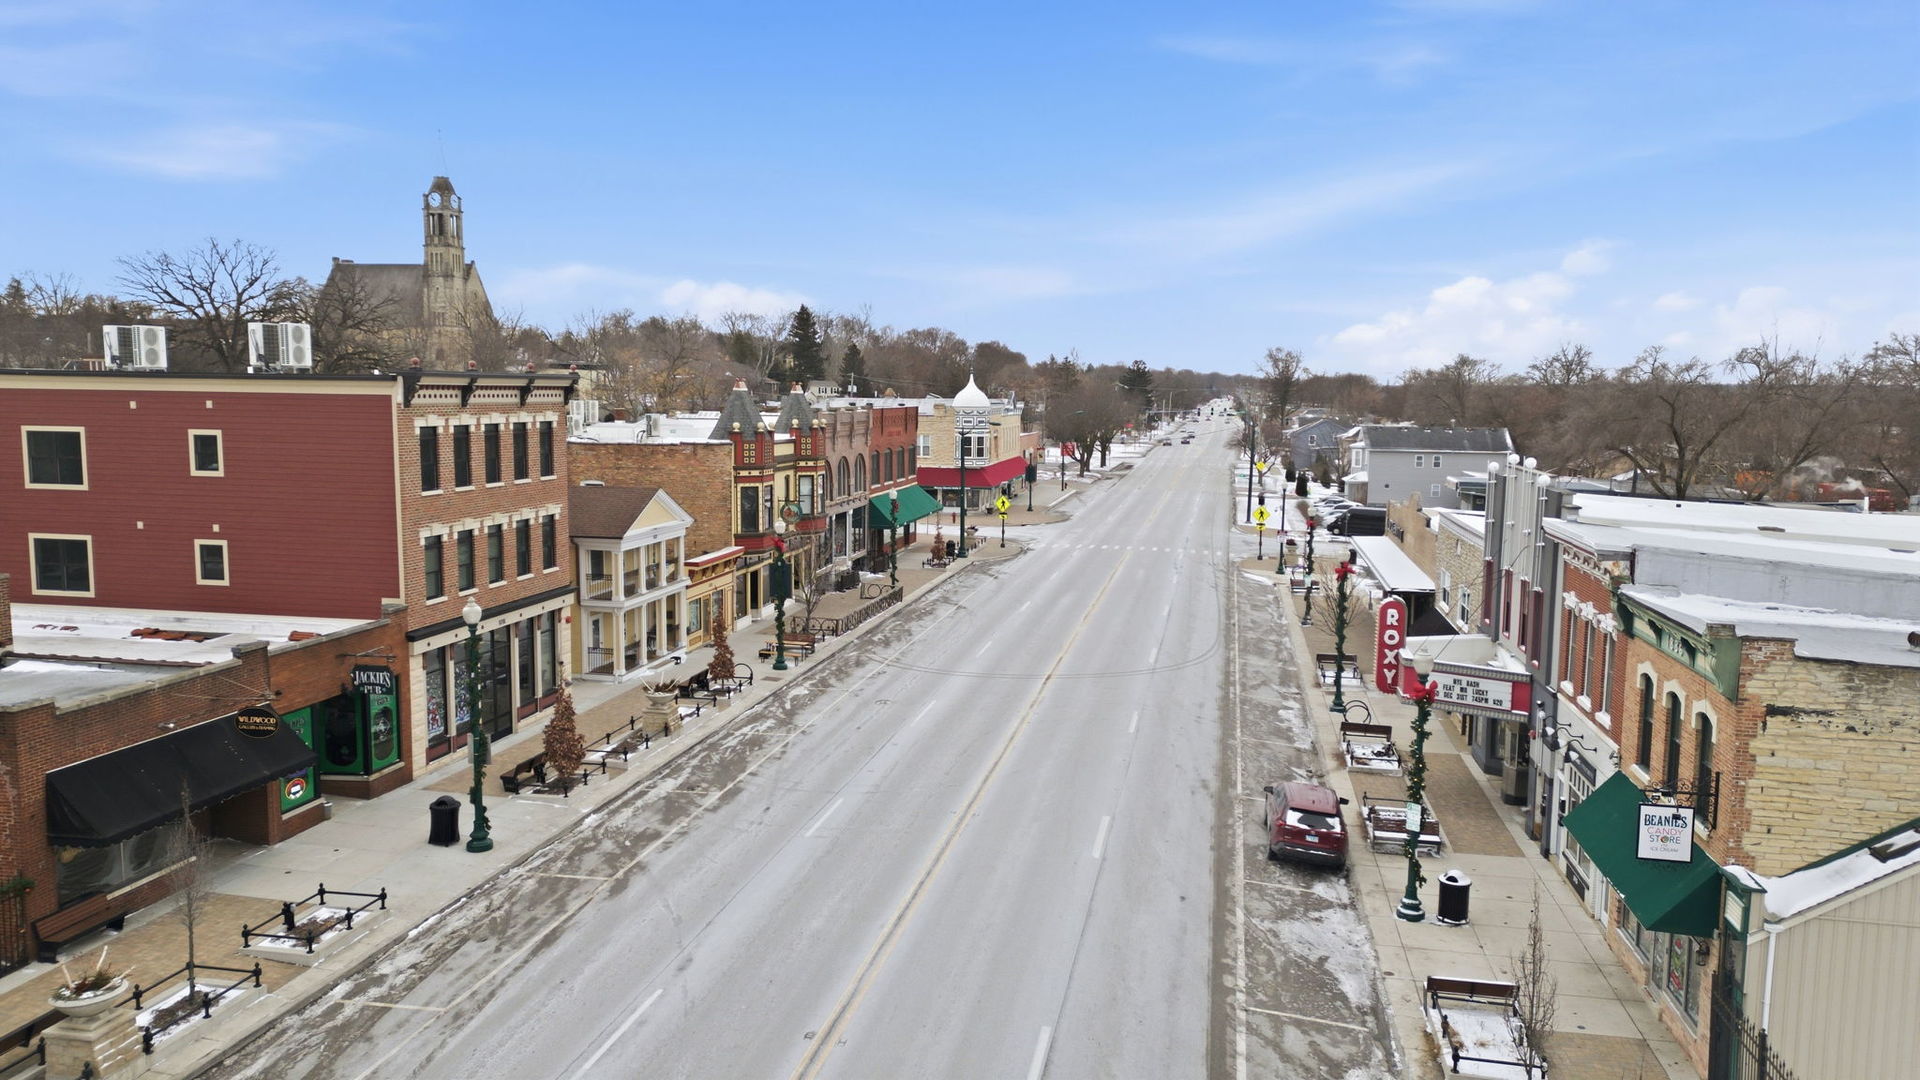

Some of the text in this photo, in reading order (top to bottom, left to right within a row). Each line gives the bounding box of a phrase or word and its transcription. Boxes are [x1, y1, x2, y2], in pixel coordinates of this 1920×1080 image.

[1383, 608, 1400, 684] ROXY
[350, 670, 391, 688] JACKIE'S
[1443, 684, 1455, 692] FEAT
[1466, 680, 1480, 688] BASH
[364, 685, 382, 694] PUB
[1443, 691, 1453, 699] DEC
[238, 716, 277, 724] WILDWOOD
[1647, 827, 1684, 836] CANDY
[1649, 834, 1681, 845] STORE
